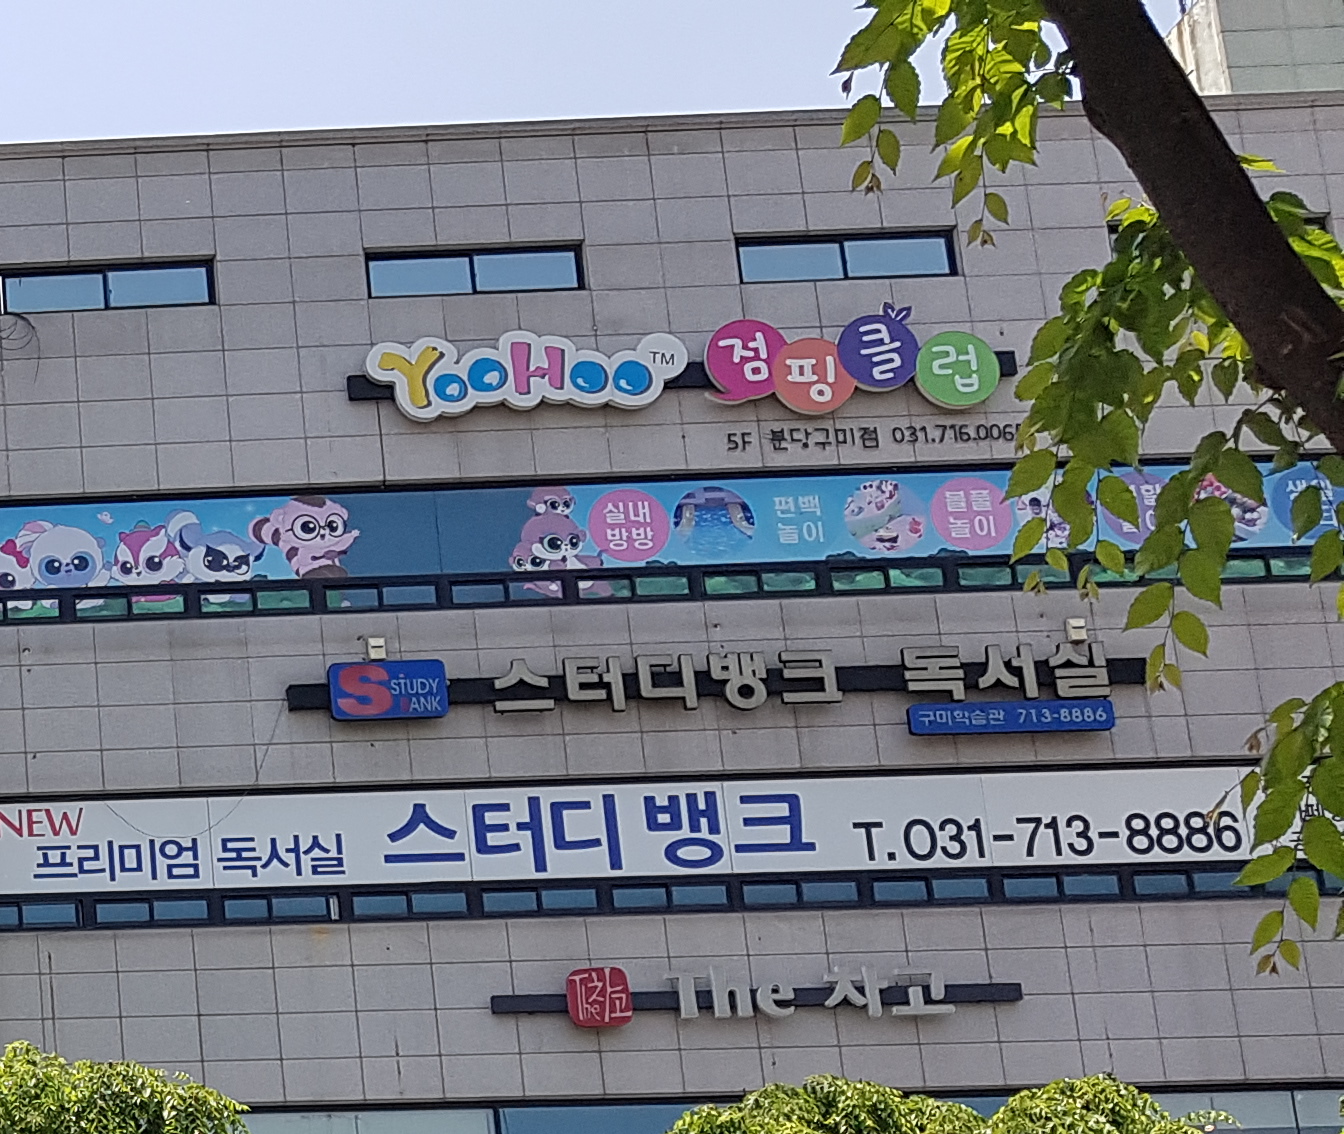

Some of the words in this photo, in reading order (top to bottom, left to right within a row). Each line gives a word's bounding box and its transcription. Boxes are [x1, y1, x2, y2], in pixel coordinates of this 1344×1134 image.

[718, 321, 978, 402] 점핑클럽
[728, 433, 753, 453] 5F
[768, 428, 879, 453] 분당구미점
[602, 501, 651, 526] 실내
[773, 495, 821, 519] 편백
[605, 526, 654, 552] 방방
[777, 520, 825, 546] 놀이
[947, 513, 997, 539] 놀이
[494, 649, 843, 712] 스터디뱅크
[902, 644, 1111, 702] 독서실
[918, 709, 1005, 726] 구미학습관
[1017, 707, 1108, 725] 713-8886
[32, 839, 201, 881] 프리미엄
[216, 834, 347, 880] 독서실
[383, 790, 817, 874] 스터디뱅크
[852, 811, 1244, 863] T.031-713-8886
[666, 966, 796, 1020] The
